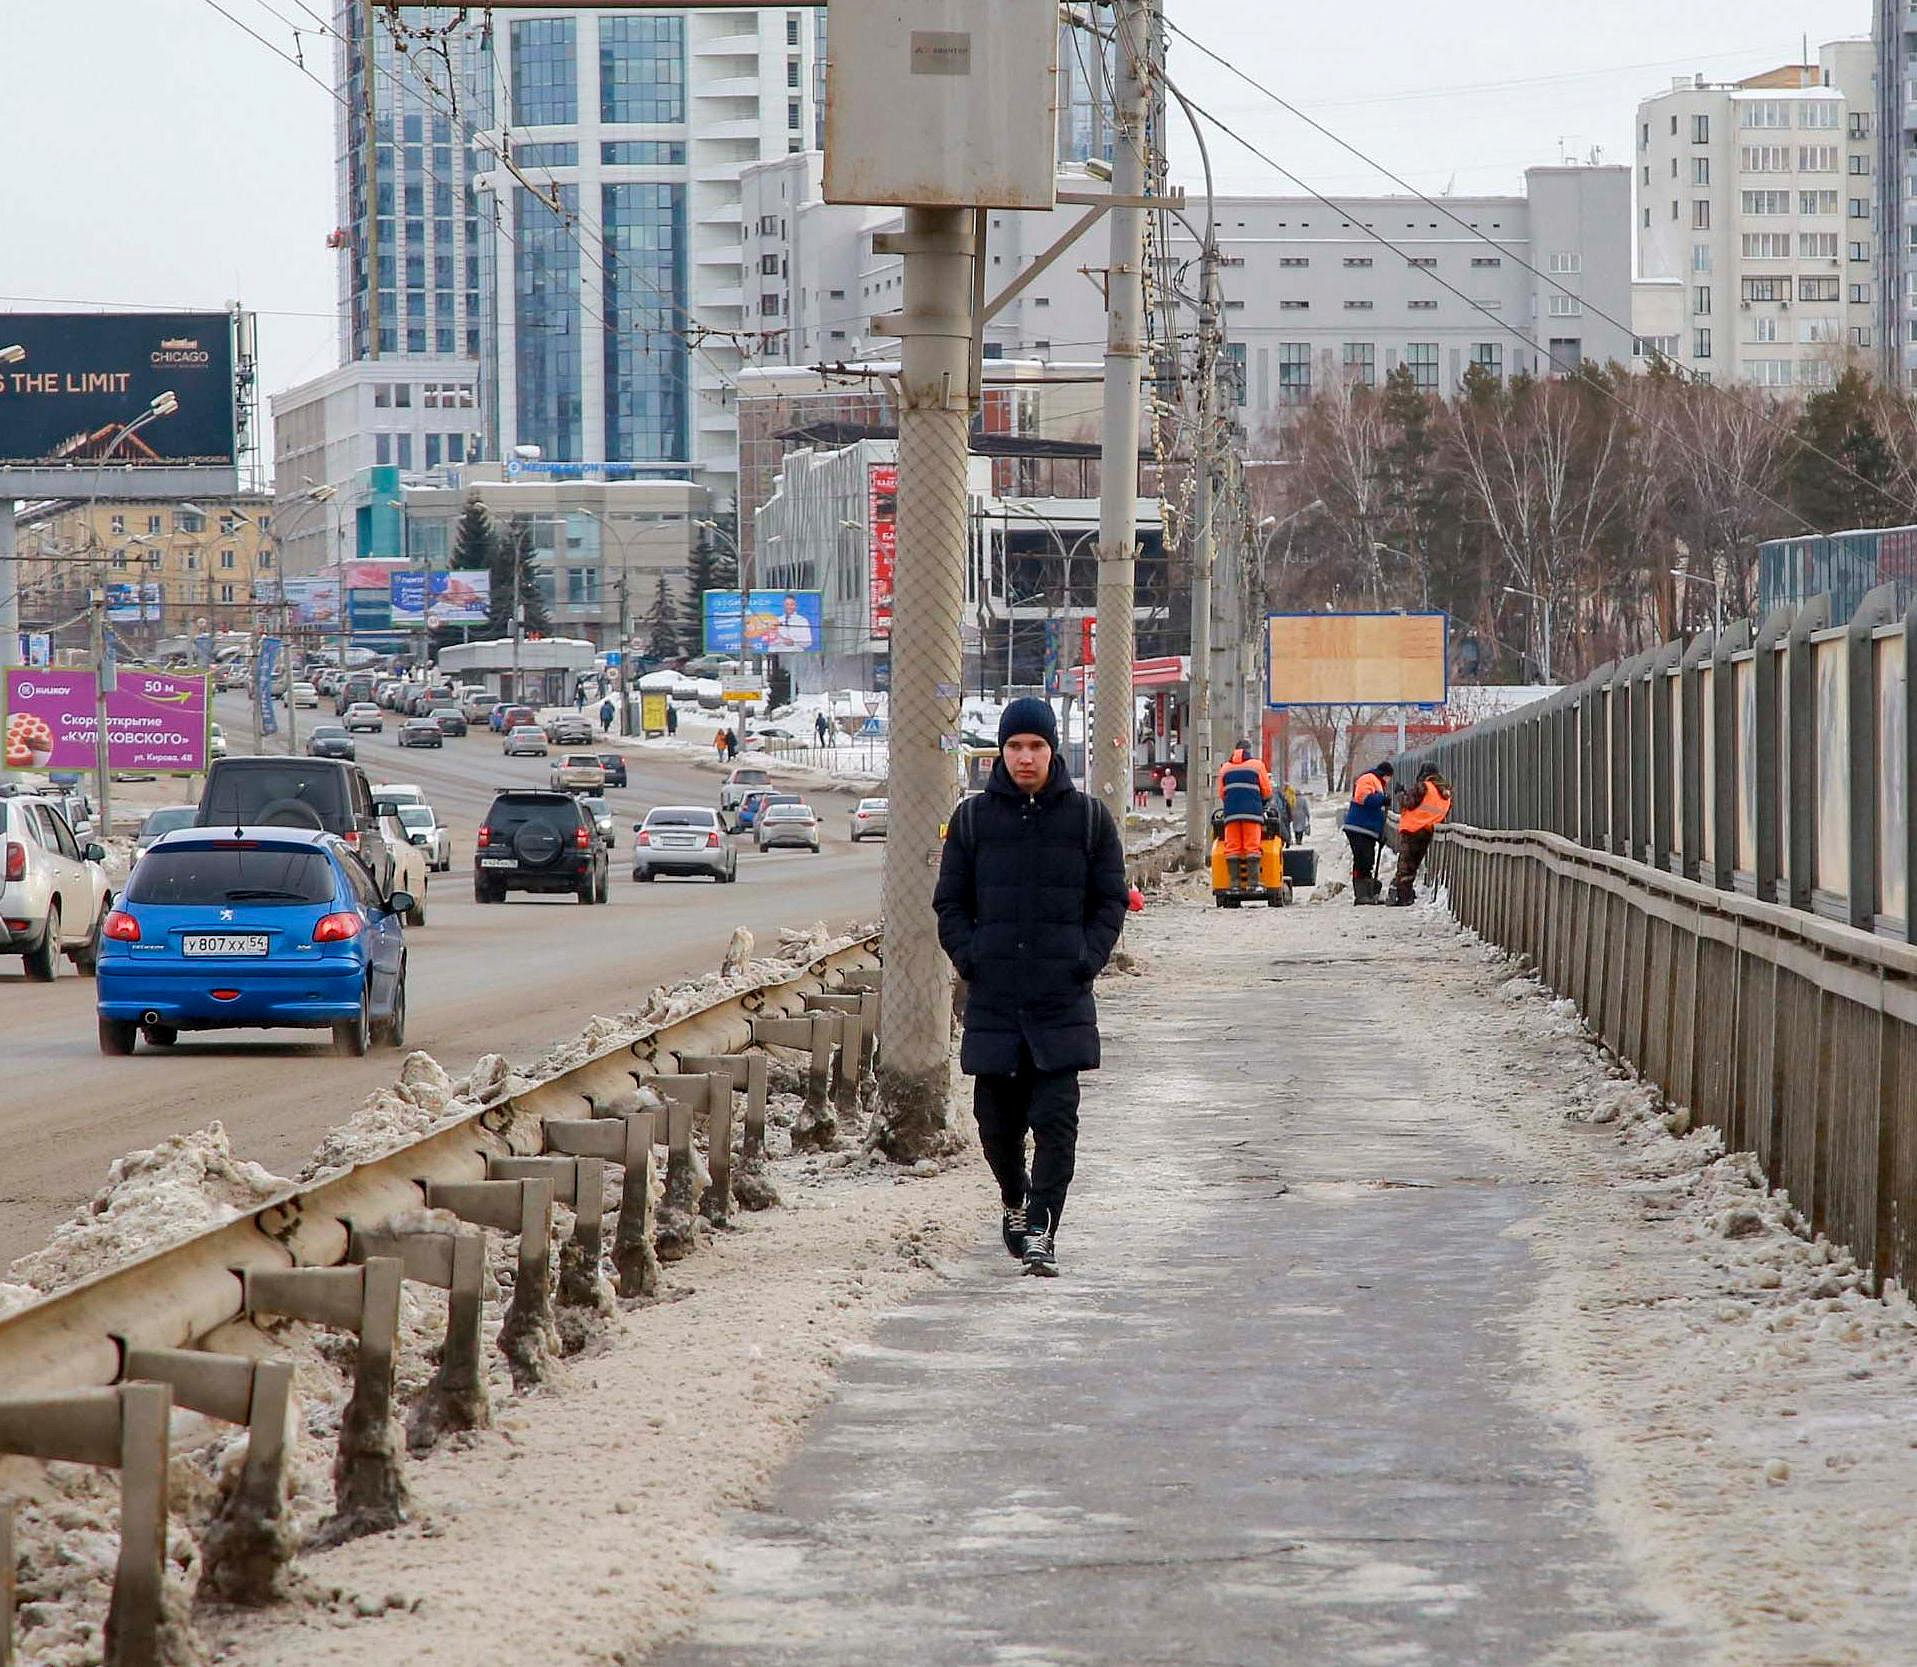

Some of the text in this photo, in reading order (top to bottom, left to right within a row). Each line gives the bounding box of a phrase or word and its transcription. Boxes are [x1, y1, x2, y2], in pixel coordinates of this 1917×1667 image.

[151, 351, 209, 362] CHICAGO
[10, 373, 59, 392] THE
[66, 372, 131, 392] LIMIT
[145, 681, 162, 692] 50
[250, 937, 264, 947] 54
